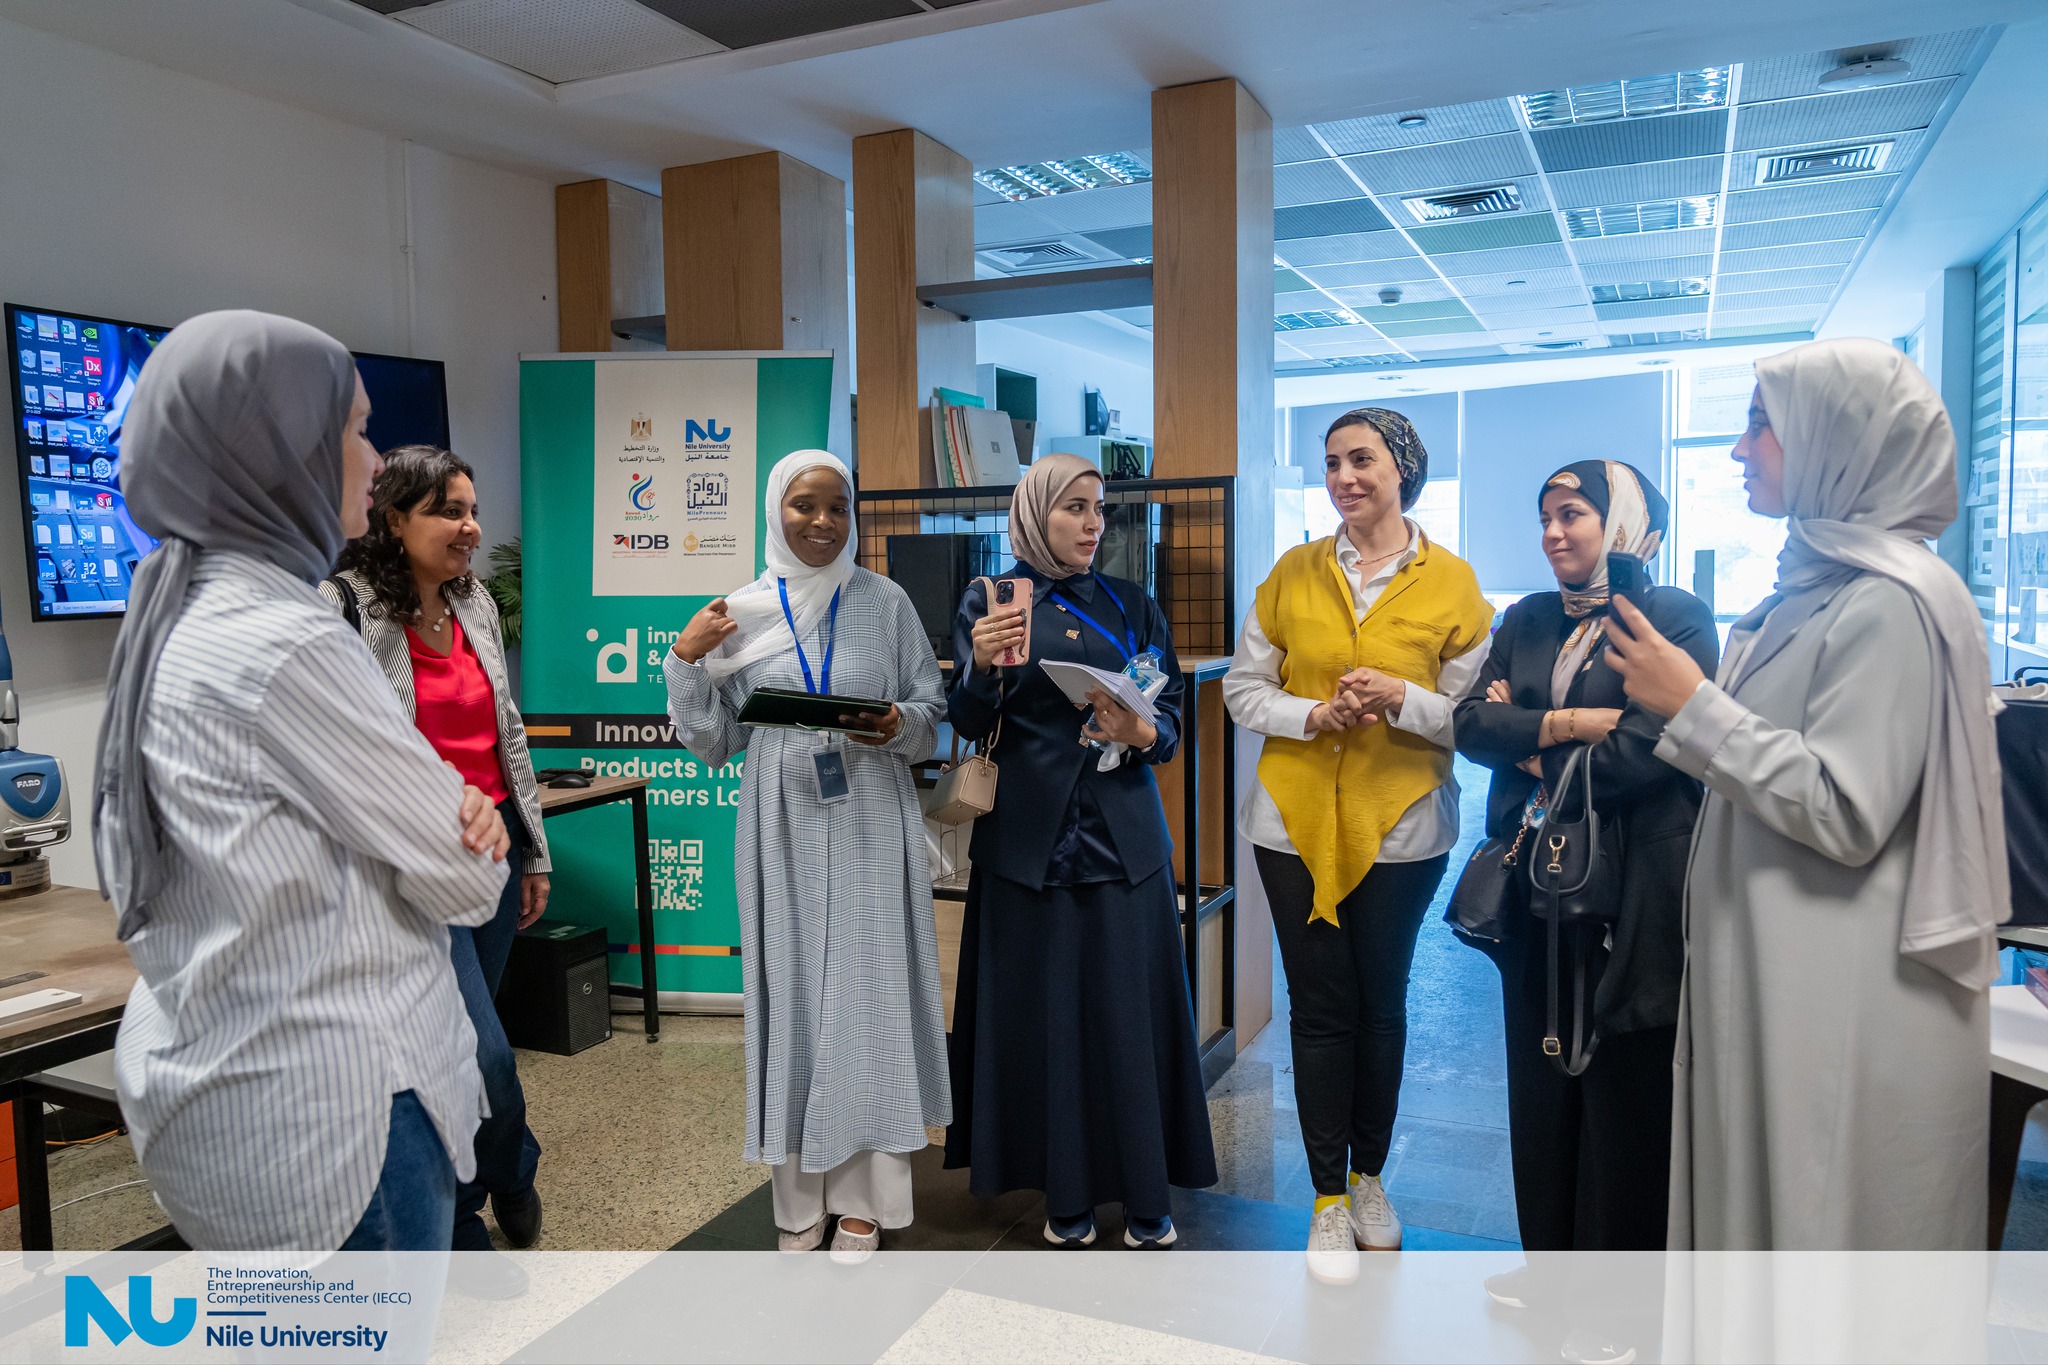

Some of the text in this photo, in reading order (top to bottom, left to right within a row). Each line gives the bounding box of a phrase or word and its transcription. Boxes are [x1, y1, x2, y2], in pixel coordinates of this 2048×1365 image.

[86, 360, 100, 372] Dx
[686, 419, 731, 443] NU
[685, 452, 729, 462] جامعة النيل
[98, 496, 112, 506] SW
[80, 528, 92, 539] Sp
[631, 535, 669, 549] IDB
[648, 674, 663, 683] TE
[596, 721, 681, 742] Innov
[581, 756, 697, 778] Products
[16, 779, 41, 788] FARO
